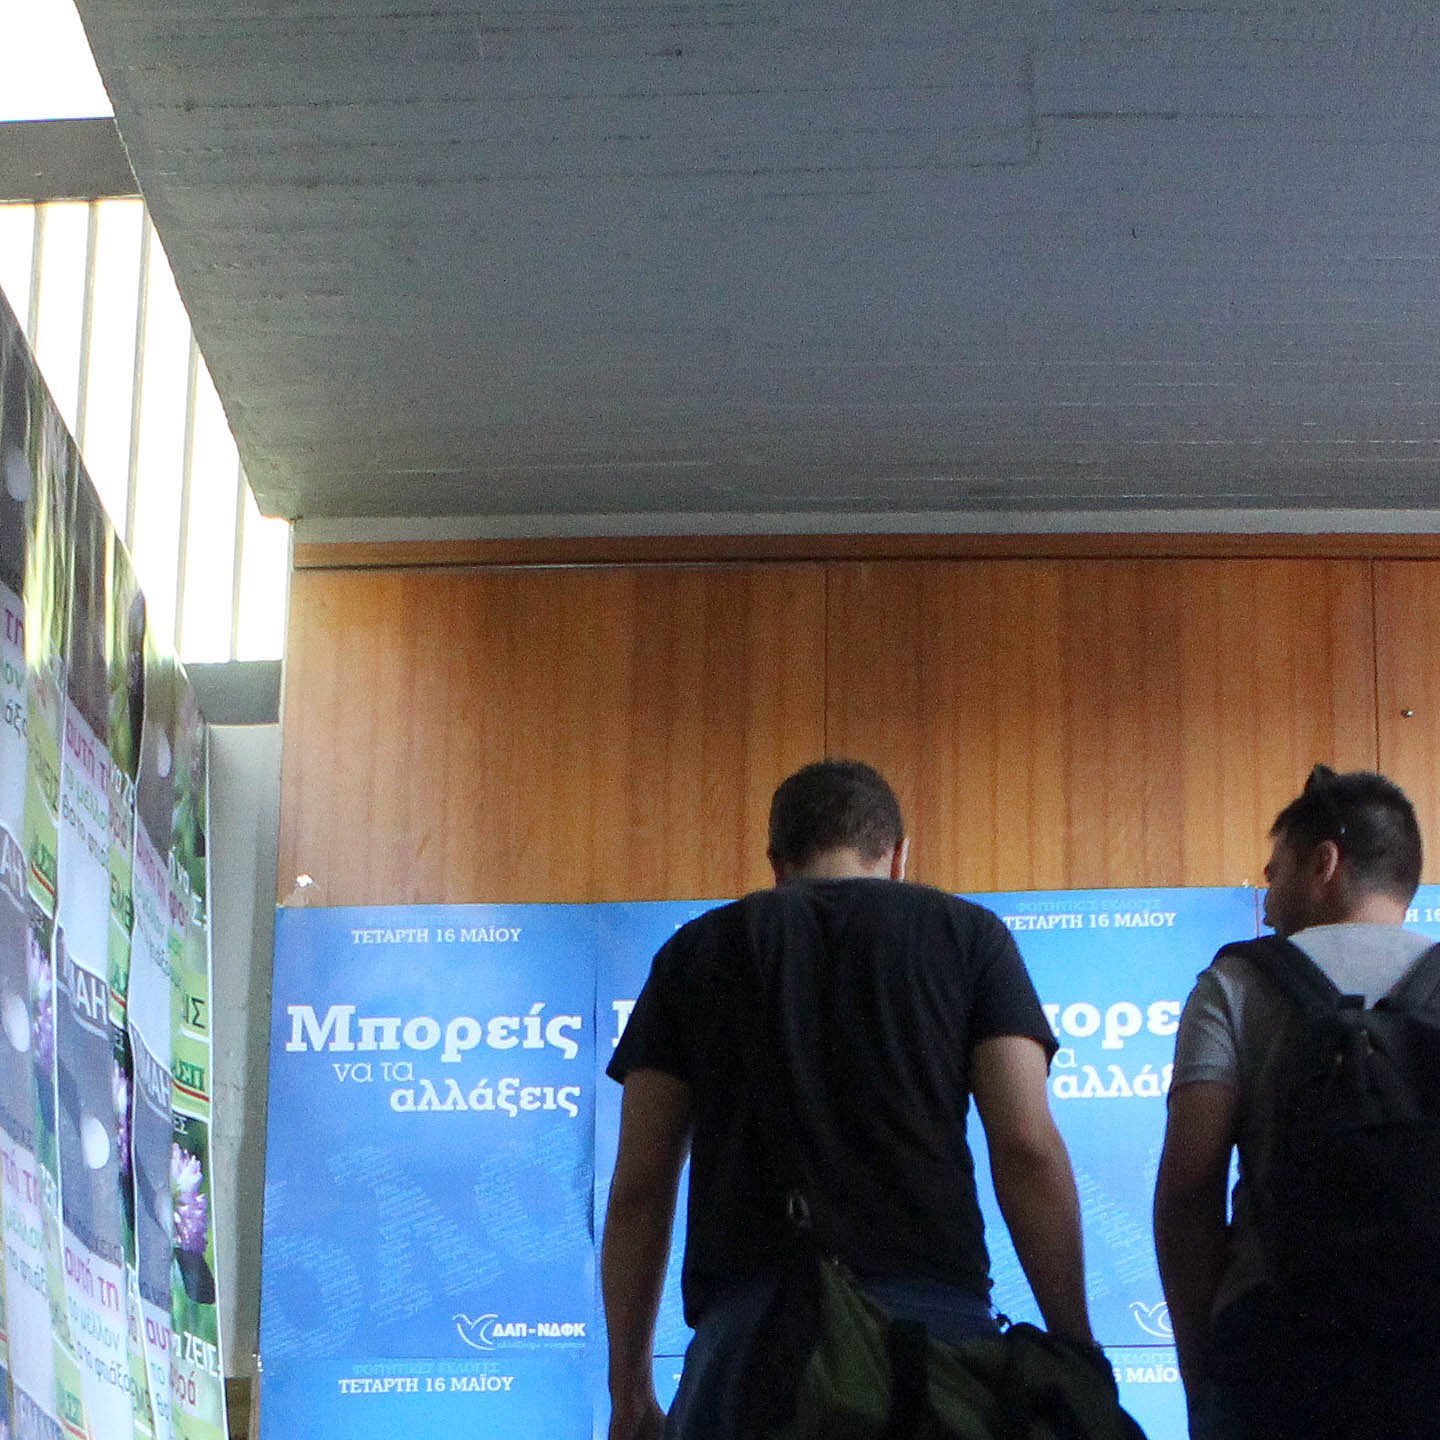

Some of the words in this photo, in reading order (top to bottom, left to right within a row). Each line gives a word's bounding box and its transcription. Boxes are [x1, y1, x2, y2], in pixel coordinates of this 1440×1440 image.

[1003, 914, 1083, 931] ΤΕΤΑΡΤΗ
[1088, 912, 1109, 929] 16
[1115, 908, 1176, 928] ΜΑΪΟΥ
[351, 929, 429, 944] ΤΕΤΑΡΤΗ
[435, 929, 456, 943] 16
[285, 1002, 583, 1063] Μπορείς
[334, 1062, 372, 1083] να
[380, 1061, 414, 1082] τα
[389, 1077, 581, 1118] αλλάξεις
[492, 1322, 586, 1337] ΔΑΠ-ΝΔΦΚ
[338, 1378, 419, 1394] ΤΕΤΑΡΤΗ
[426, 1377, 446, 1393] 16
[450, 1374, 515, 1392] ΜΑΪΟΥ
[1124, 1365, 1179, 1384] ΜΑΪΟ
